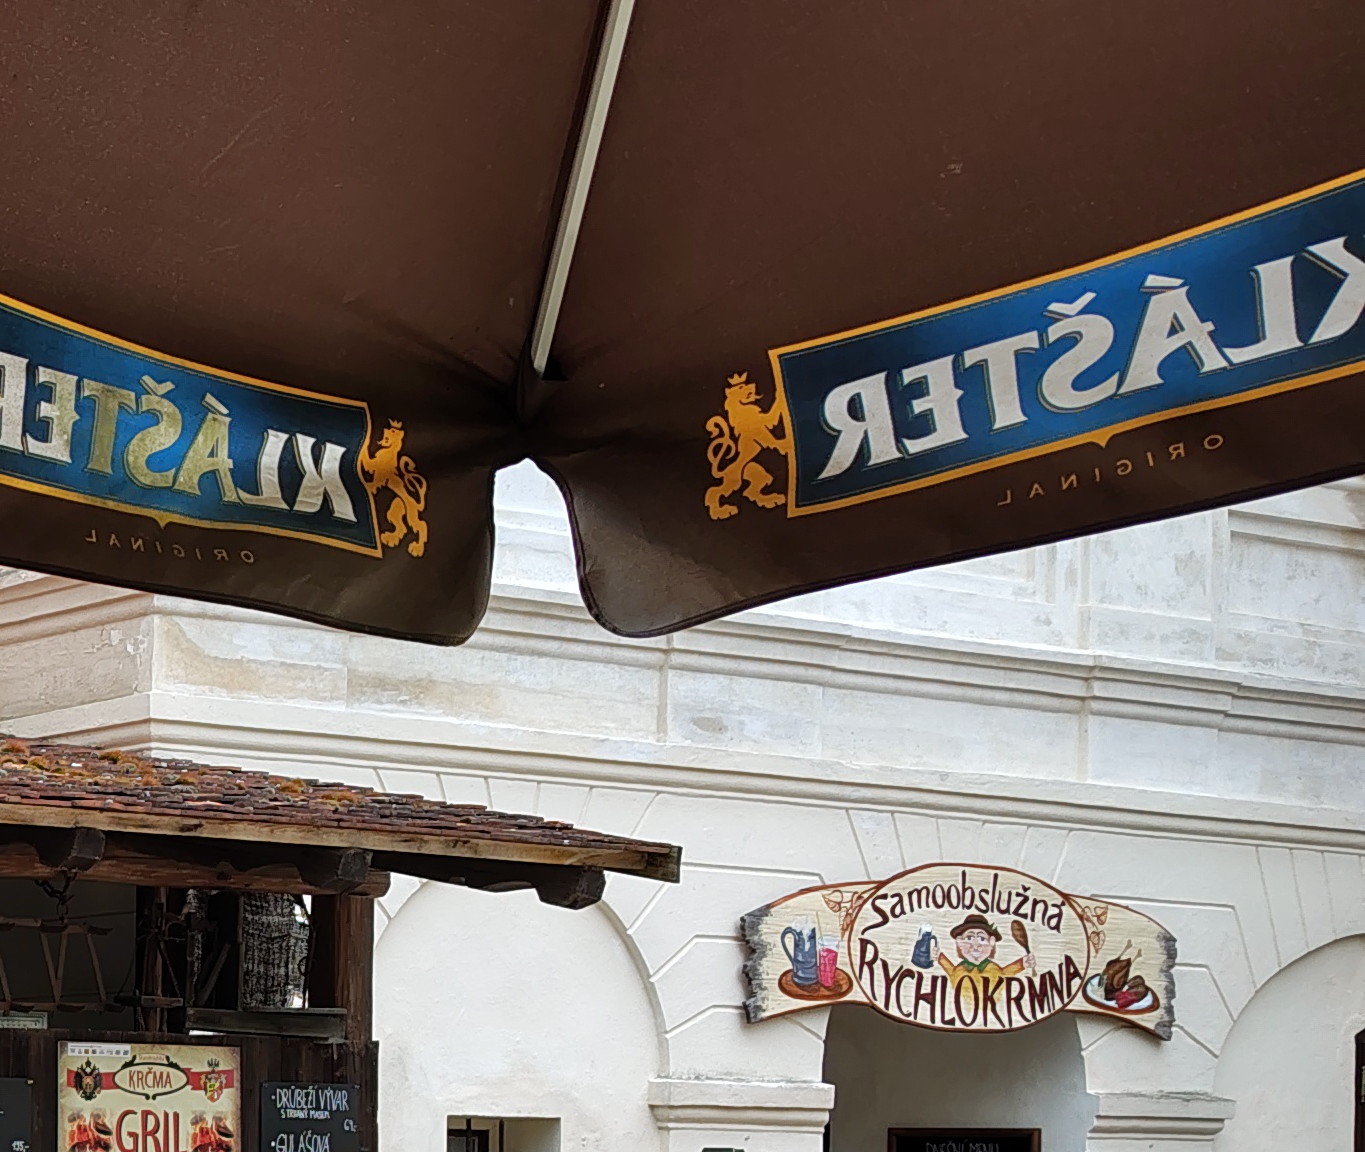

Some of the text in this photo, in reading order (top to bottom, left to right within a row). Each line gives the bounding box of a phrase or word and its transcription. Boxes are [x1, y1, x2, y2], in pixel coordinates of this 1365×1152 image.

[860, 869, 1067, 936] Samoobslužná
[858, 937, 1084, 1029] RYCHLOKRMNA
[128, 1067, 173, 1091] KRČMA
[276, 1085, 349, 1111] DRŮBEŽÍ VÝVAR
